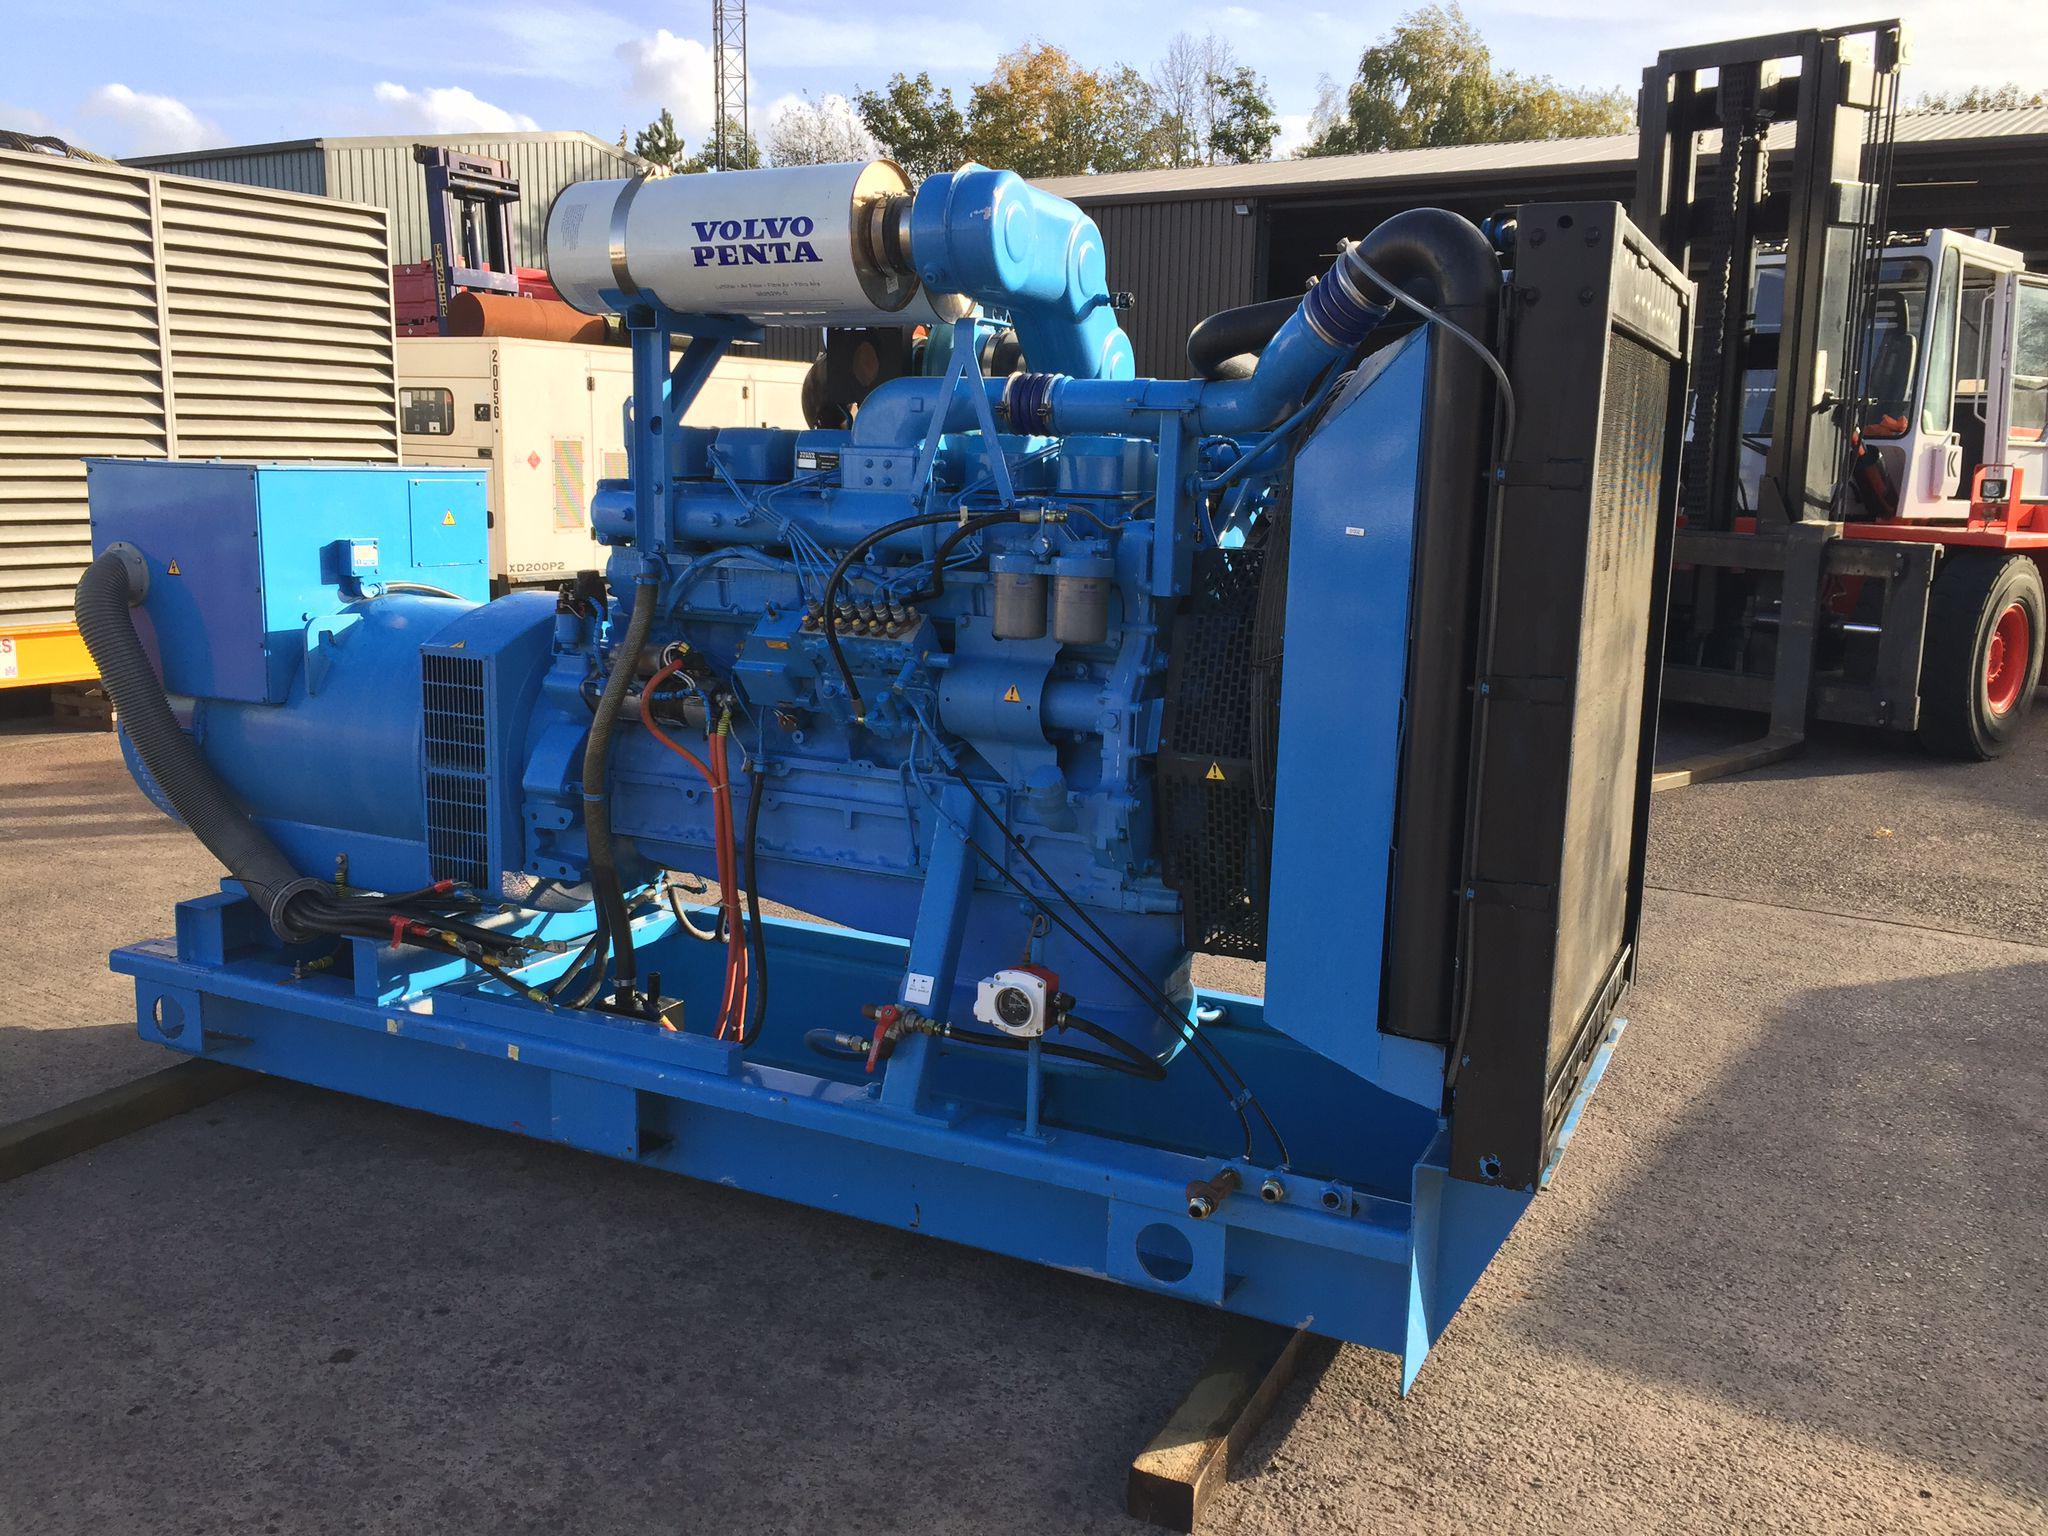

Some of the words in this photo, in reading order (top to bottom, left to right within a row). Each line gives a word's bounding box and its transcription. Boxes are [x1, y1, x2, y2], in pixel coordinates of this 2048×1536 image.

[691, 216, 814, 242] VOLVO
[691, 241, 823, 267] PENTA
[434, 243, 448, 317] HYSTER
[509, 561, 565, 573] XD200P2
